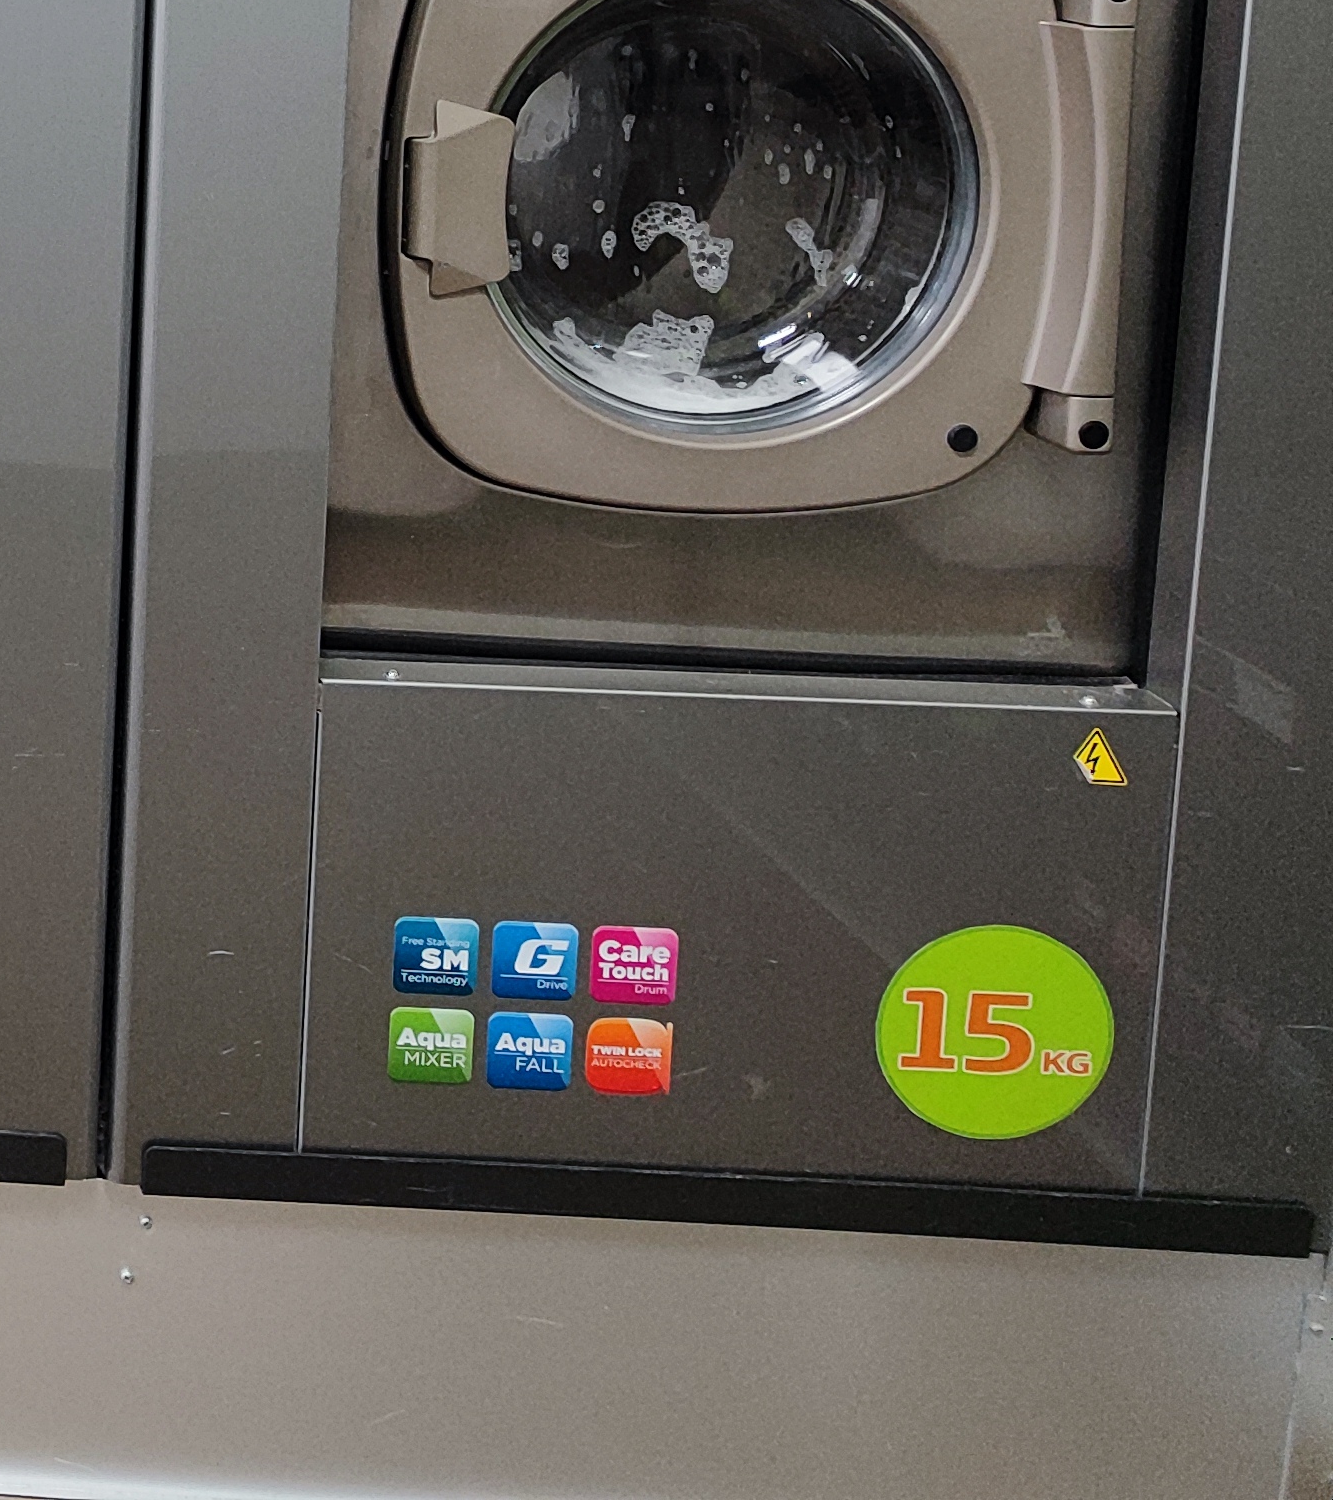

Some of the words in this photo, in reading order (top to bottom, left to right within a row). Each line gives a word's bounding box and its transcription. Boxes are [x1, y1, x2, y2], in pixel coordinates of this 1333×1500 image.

[494, 1029, 565, 1056] Aqua
[898, 988, 1035, 1075] 15
[1040, 1050, 1092, 1076] KG
[515, 1056, 566, 1074] FALL
[591, 1057, 662, 1070] AUTOCHECK
